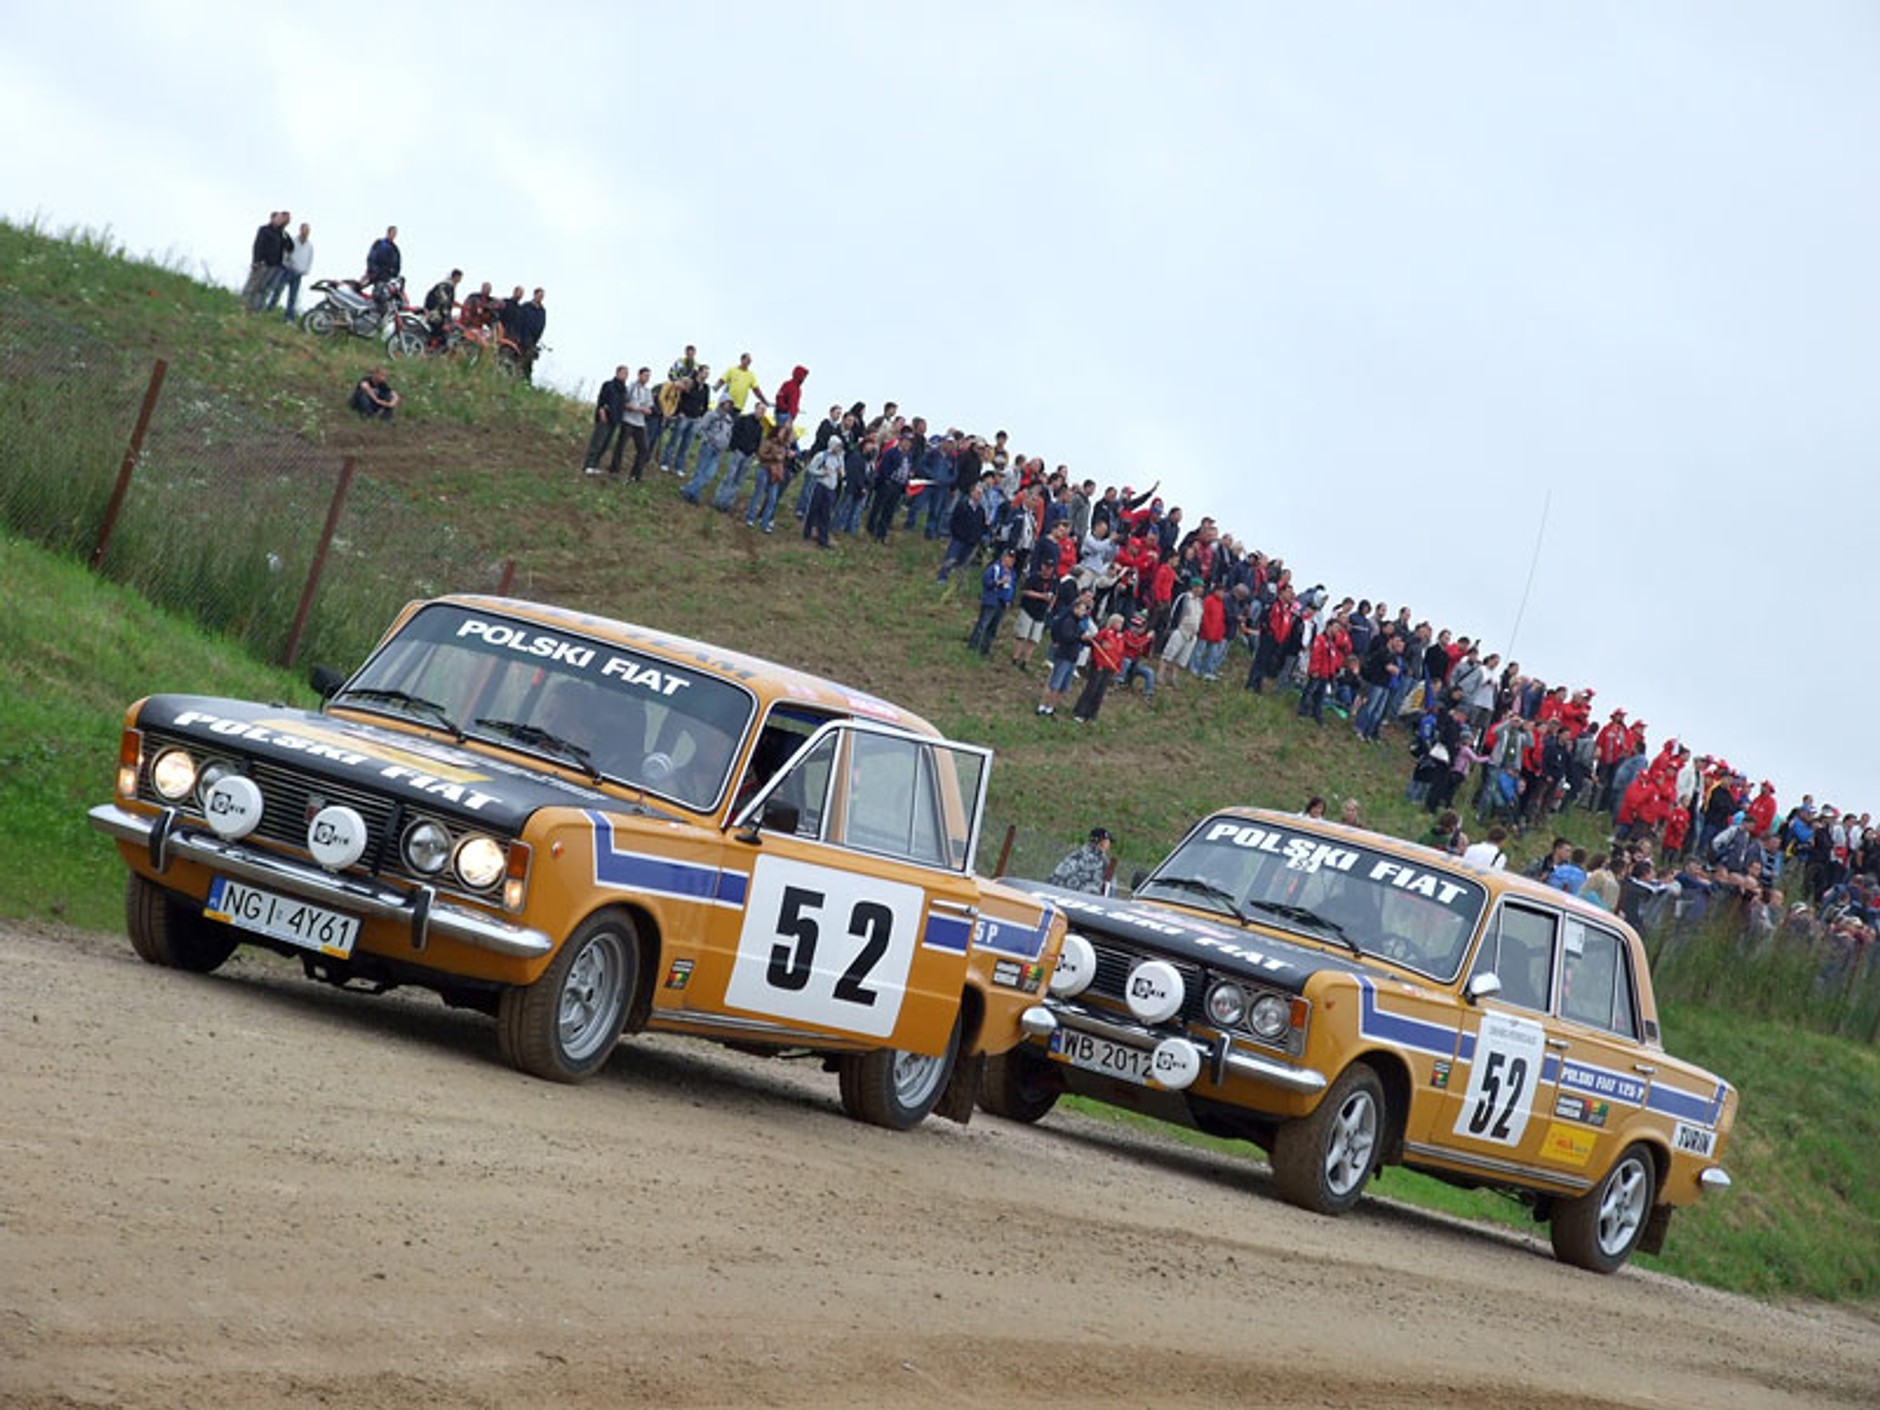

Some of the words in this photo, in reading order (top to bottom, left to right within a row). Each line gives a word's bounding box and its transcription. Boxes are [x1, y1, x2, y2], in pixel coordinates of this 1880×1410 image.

[457, 620, 596, 668] POLSKI
[601, 657, 690, 696] FIAT
[173, 711, 369, 765] POLSKI
[380, 765, 502, 810] FIAT
[1206, 823, 1360, 871] POLSKI
[1368, 860, 1468, 904] FIAT
[223, 886, 276, 925] NGI
[288, 907, 350, 947] 4Y61
[766, 886, 895, 1007] 52
[1195, 937, 1294, 970] FIAT
[1063, 1032, 1094, 1061] WB
[1560, 1066, 1594, 1087] POLSKI
[1469, 1052, 1528, 1139] 52
[1678, 1124, 1713, 1155] TURIN
